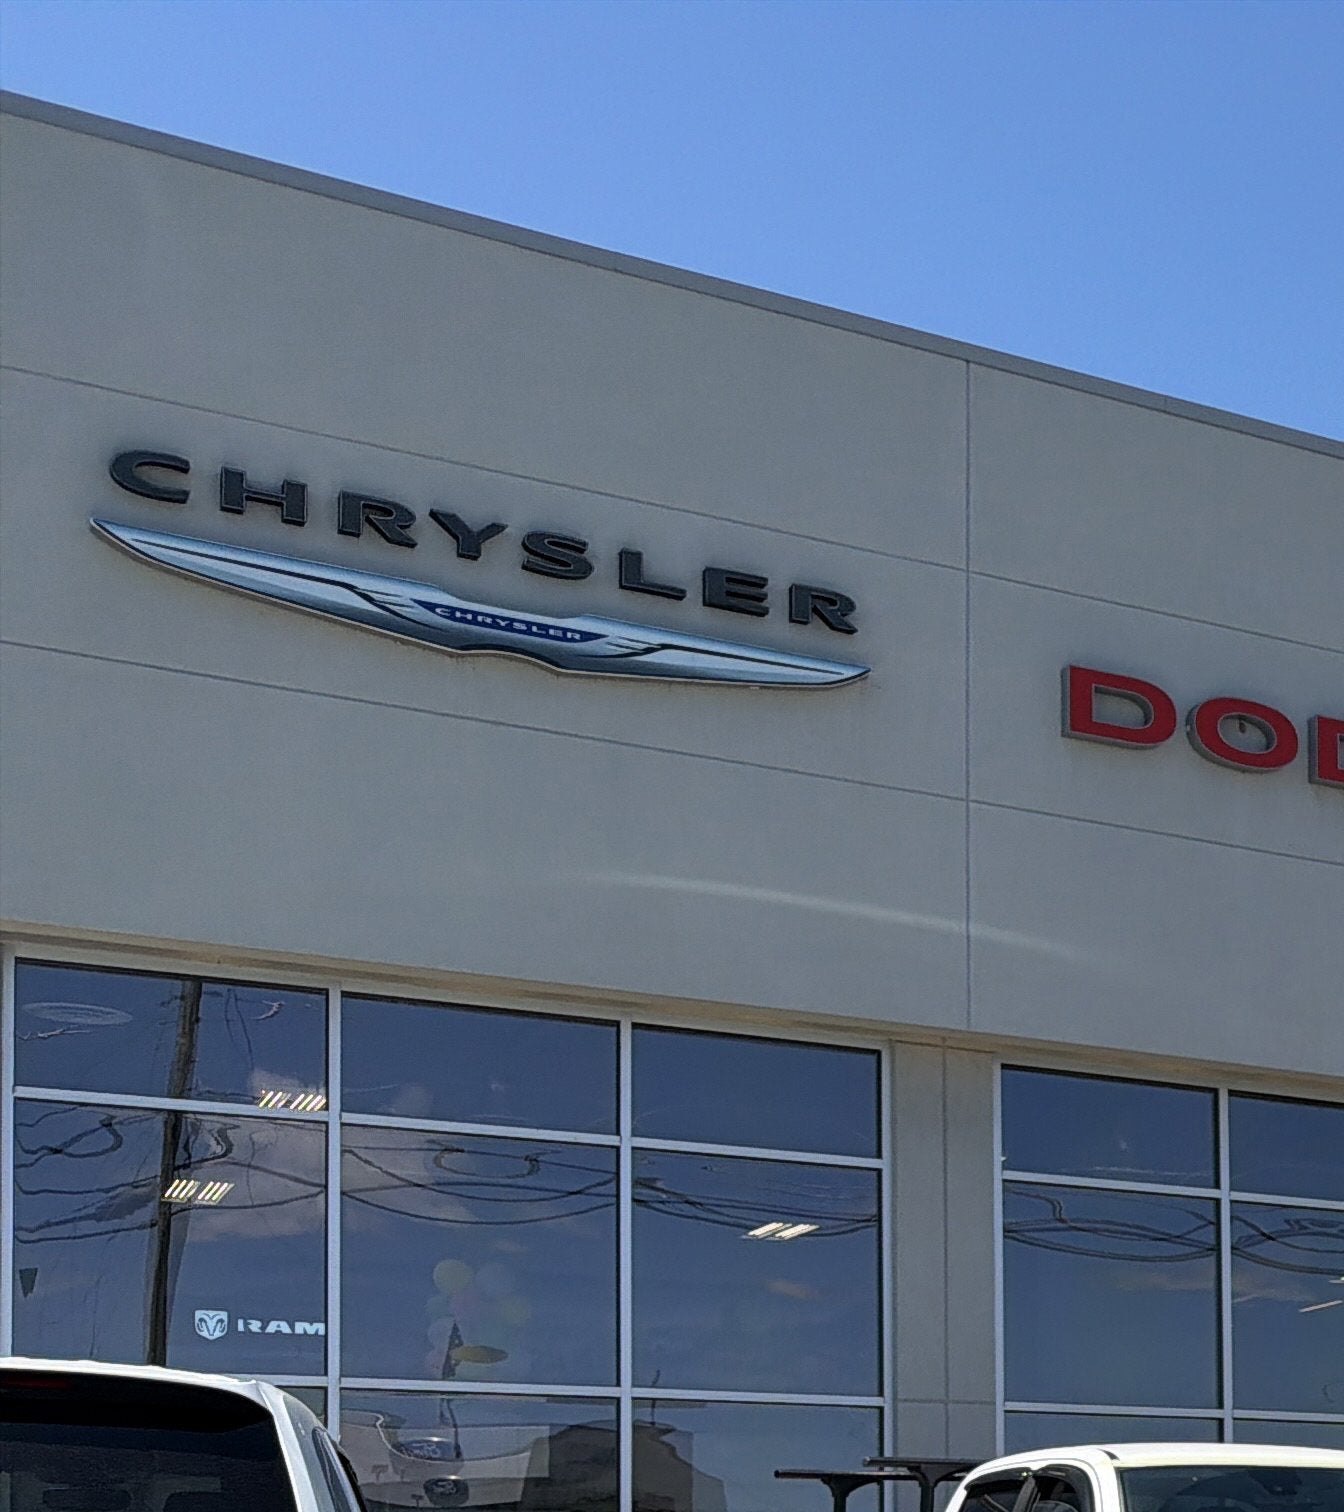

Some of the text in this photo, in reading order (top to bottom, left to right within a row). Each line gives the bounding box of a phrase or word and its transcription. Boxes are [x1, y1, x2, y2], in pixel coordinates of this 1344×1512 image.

[109, 449, 858, 634] CHRYSLER
[435, 607, 581, 640] CHRYSLER
[237, 1318, 325, 1336] RAM
